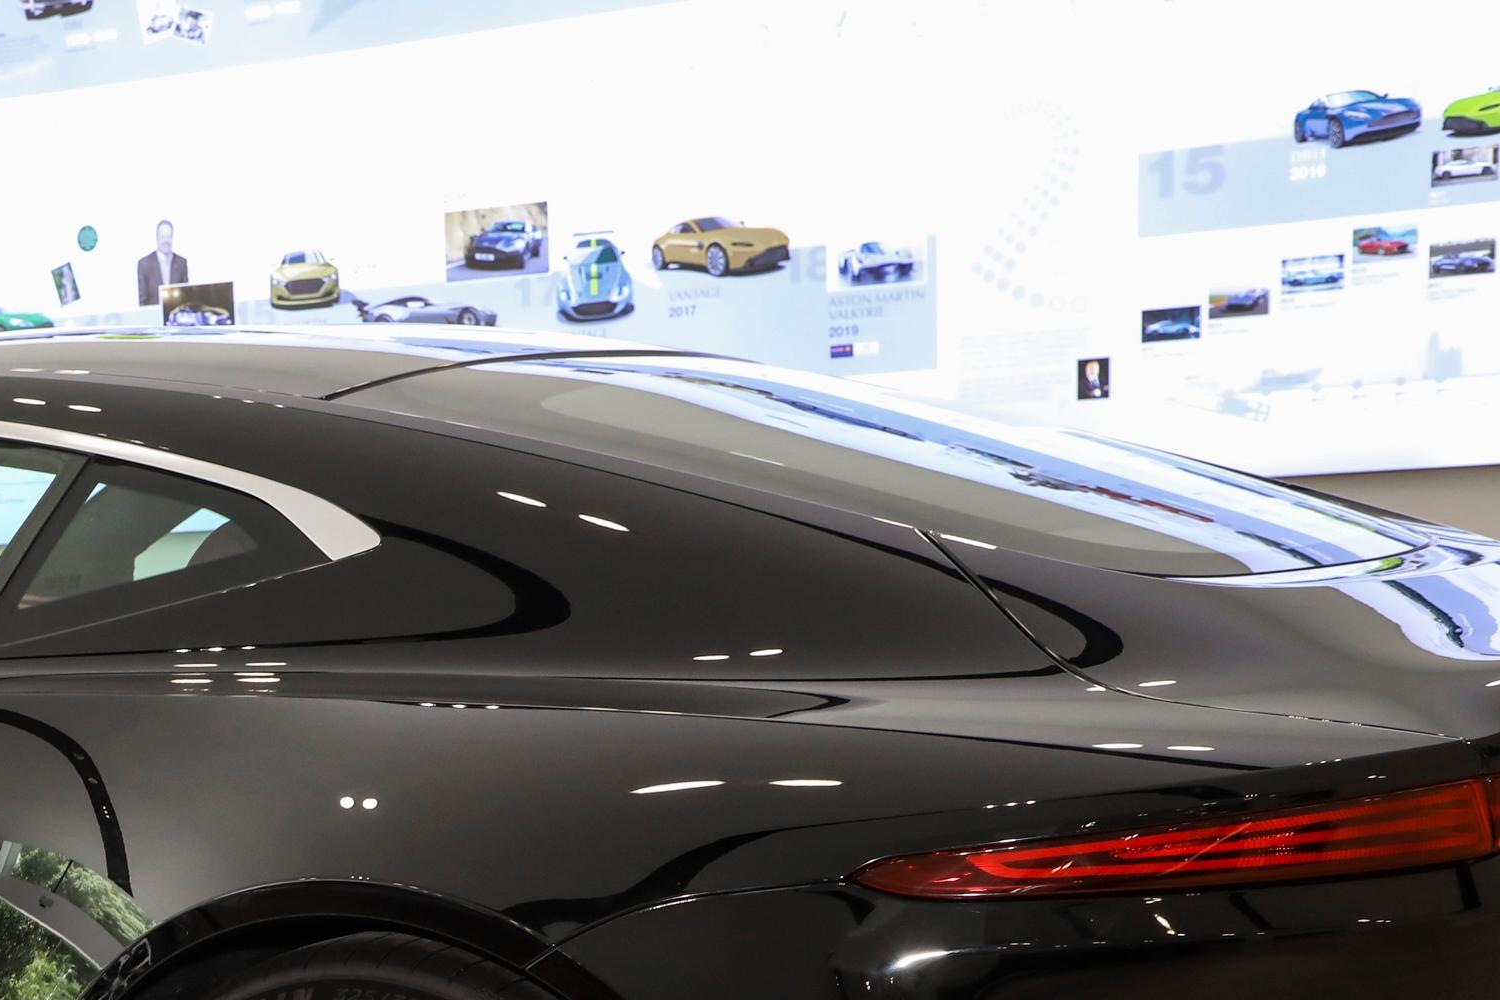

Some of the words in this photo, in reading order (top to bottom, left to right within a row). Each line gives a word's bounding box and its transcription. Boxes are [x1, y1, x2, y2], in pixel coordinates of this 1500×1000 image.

[1147, 144, 1227, 199] 15
[1288, 164, 1327, 182] 2016
[667, 303, 698, 319] 2017
[828, 323, 860, 339] 2019
